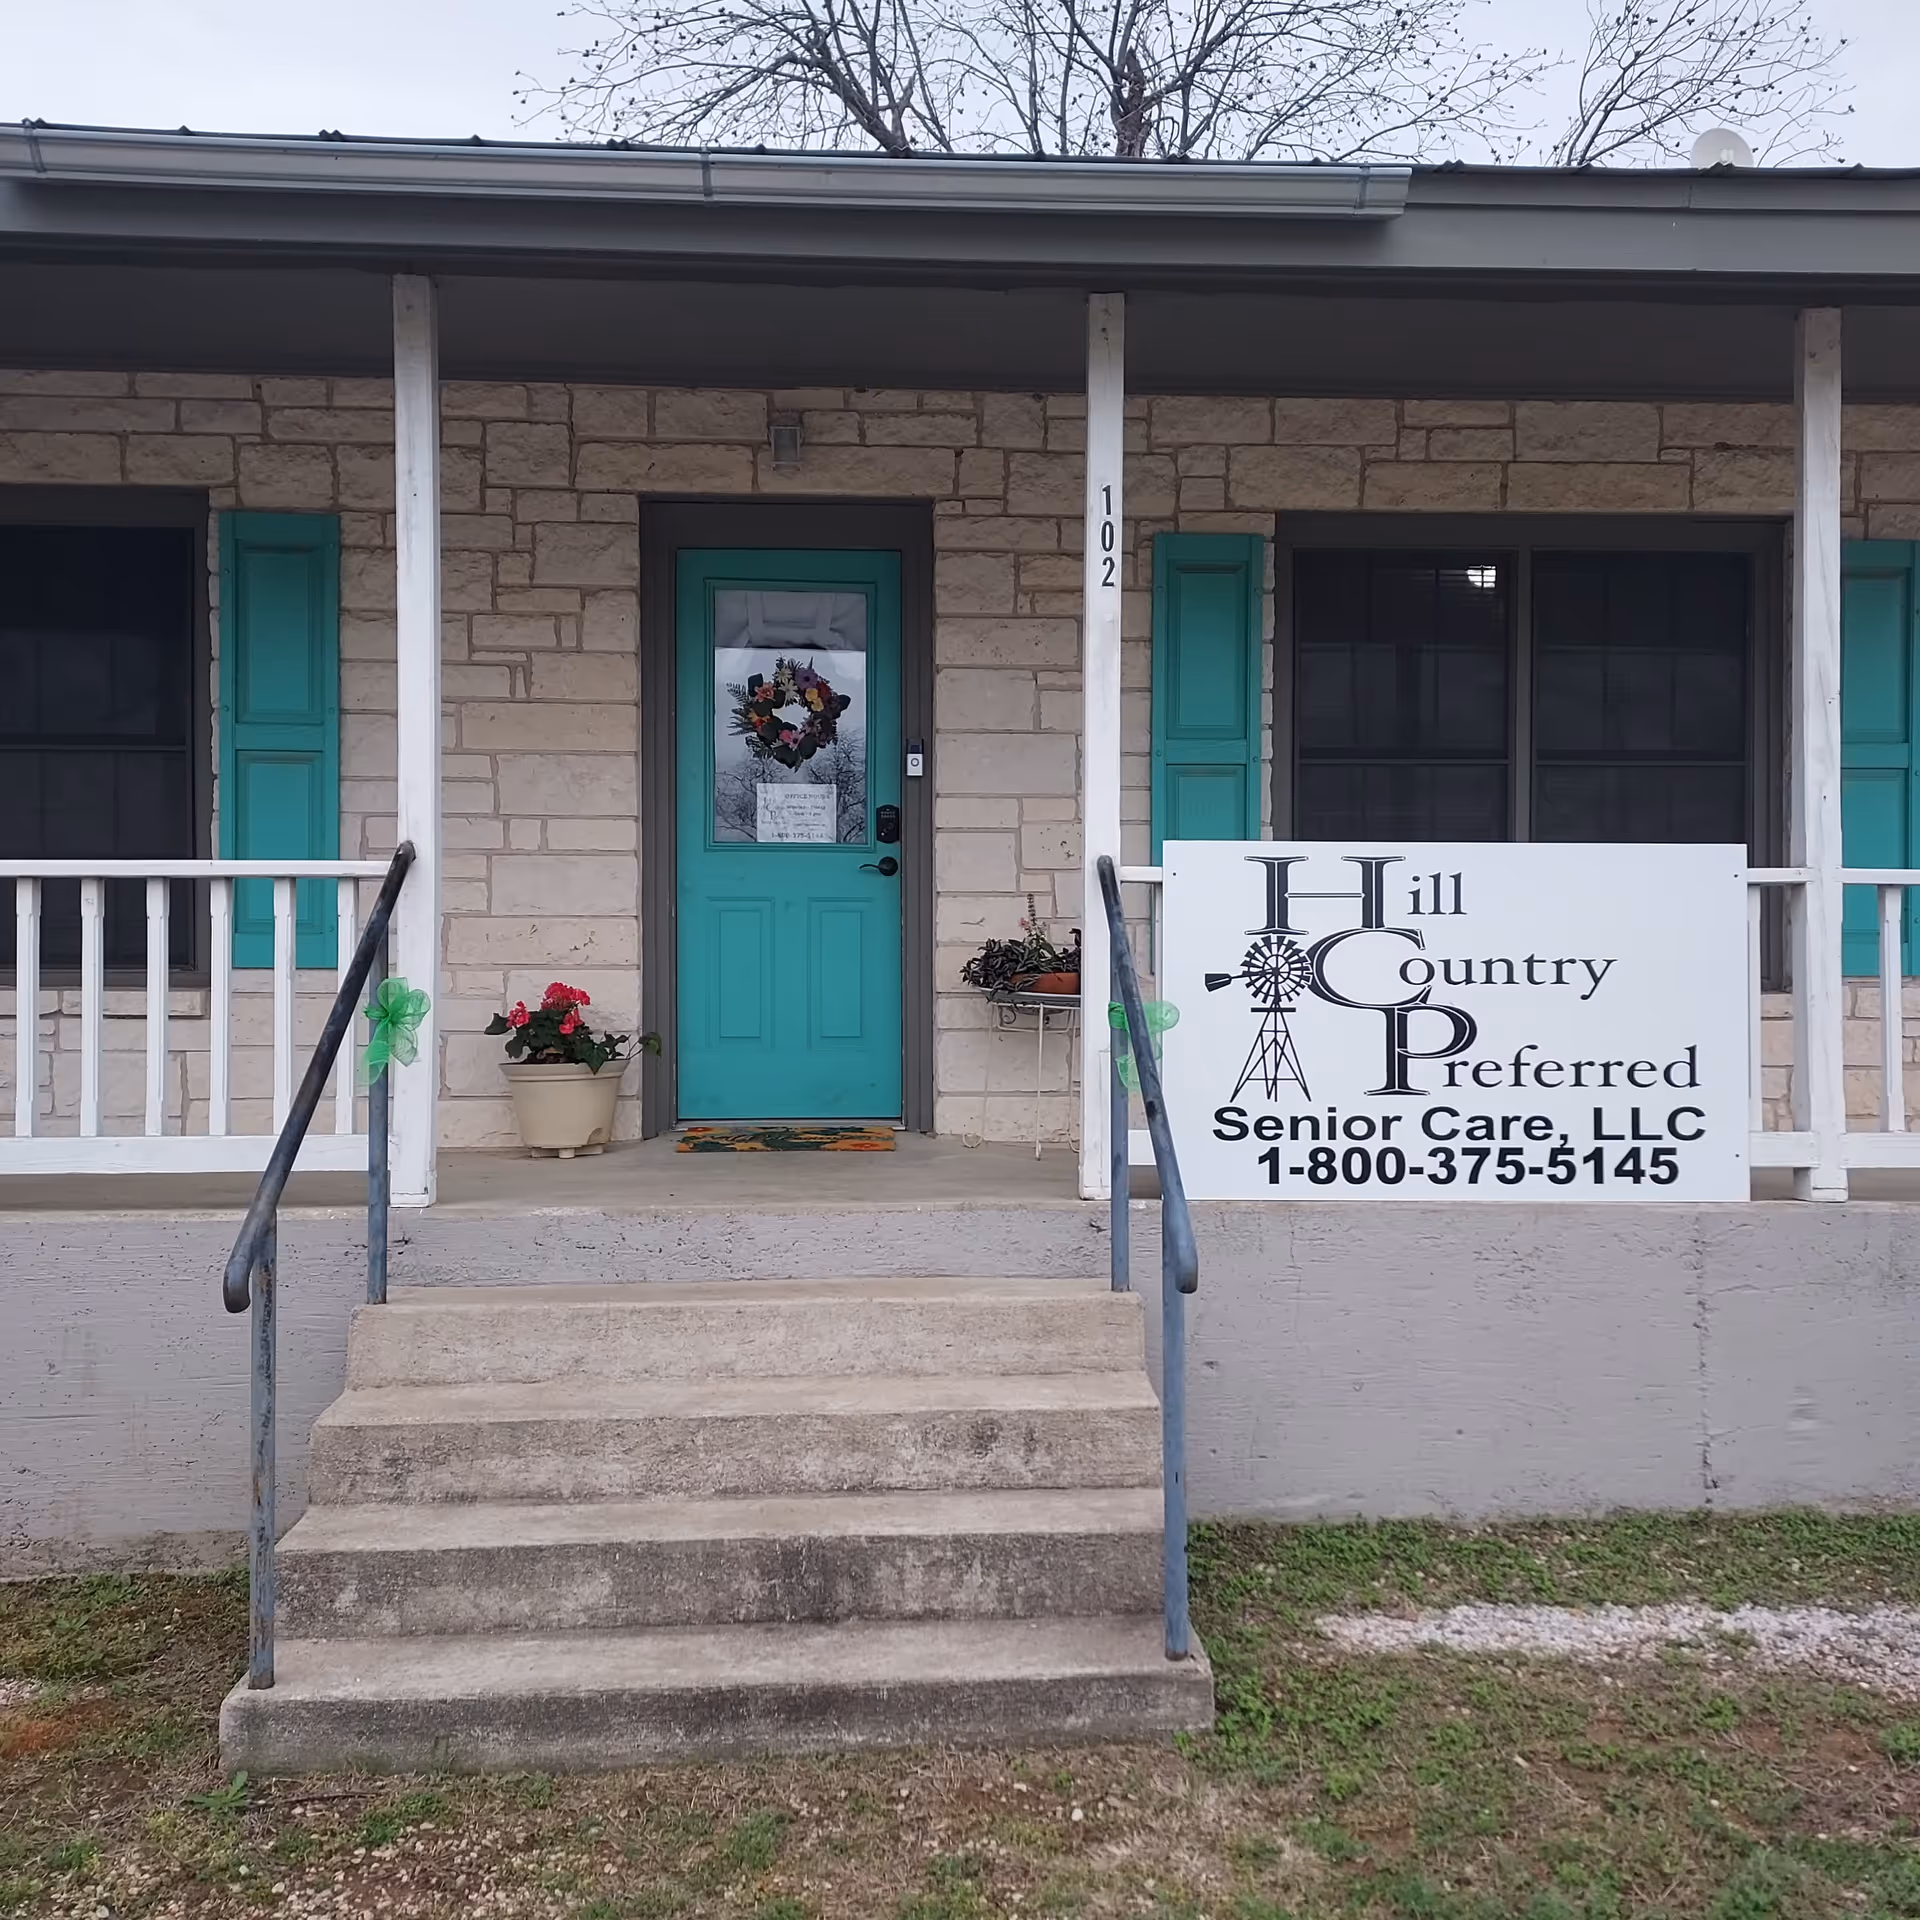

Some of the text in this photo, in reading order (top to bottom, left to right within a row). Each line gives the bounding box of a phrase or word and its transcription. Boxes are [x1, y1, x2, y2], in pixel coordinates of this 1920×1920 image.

[1101, 484, 1115, 587] 102
[1244, 855, 1468, 936] Hill
[1306, 927, 1618, 1010] Country
[1363, 999, 1703, 1096] Preferred
[1212, 1105, 1707, 1149] Senior Care, LLC
[1257, 1146, 1680, 1185] 1-800-375-5145
